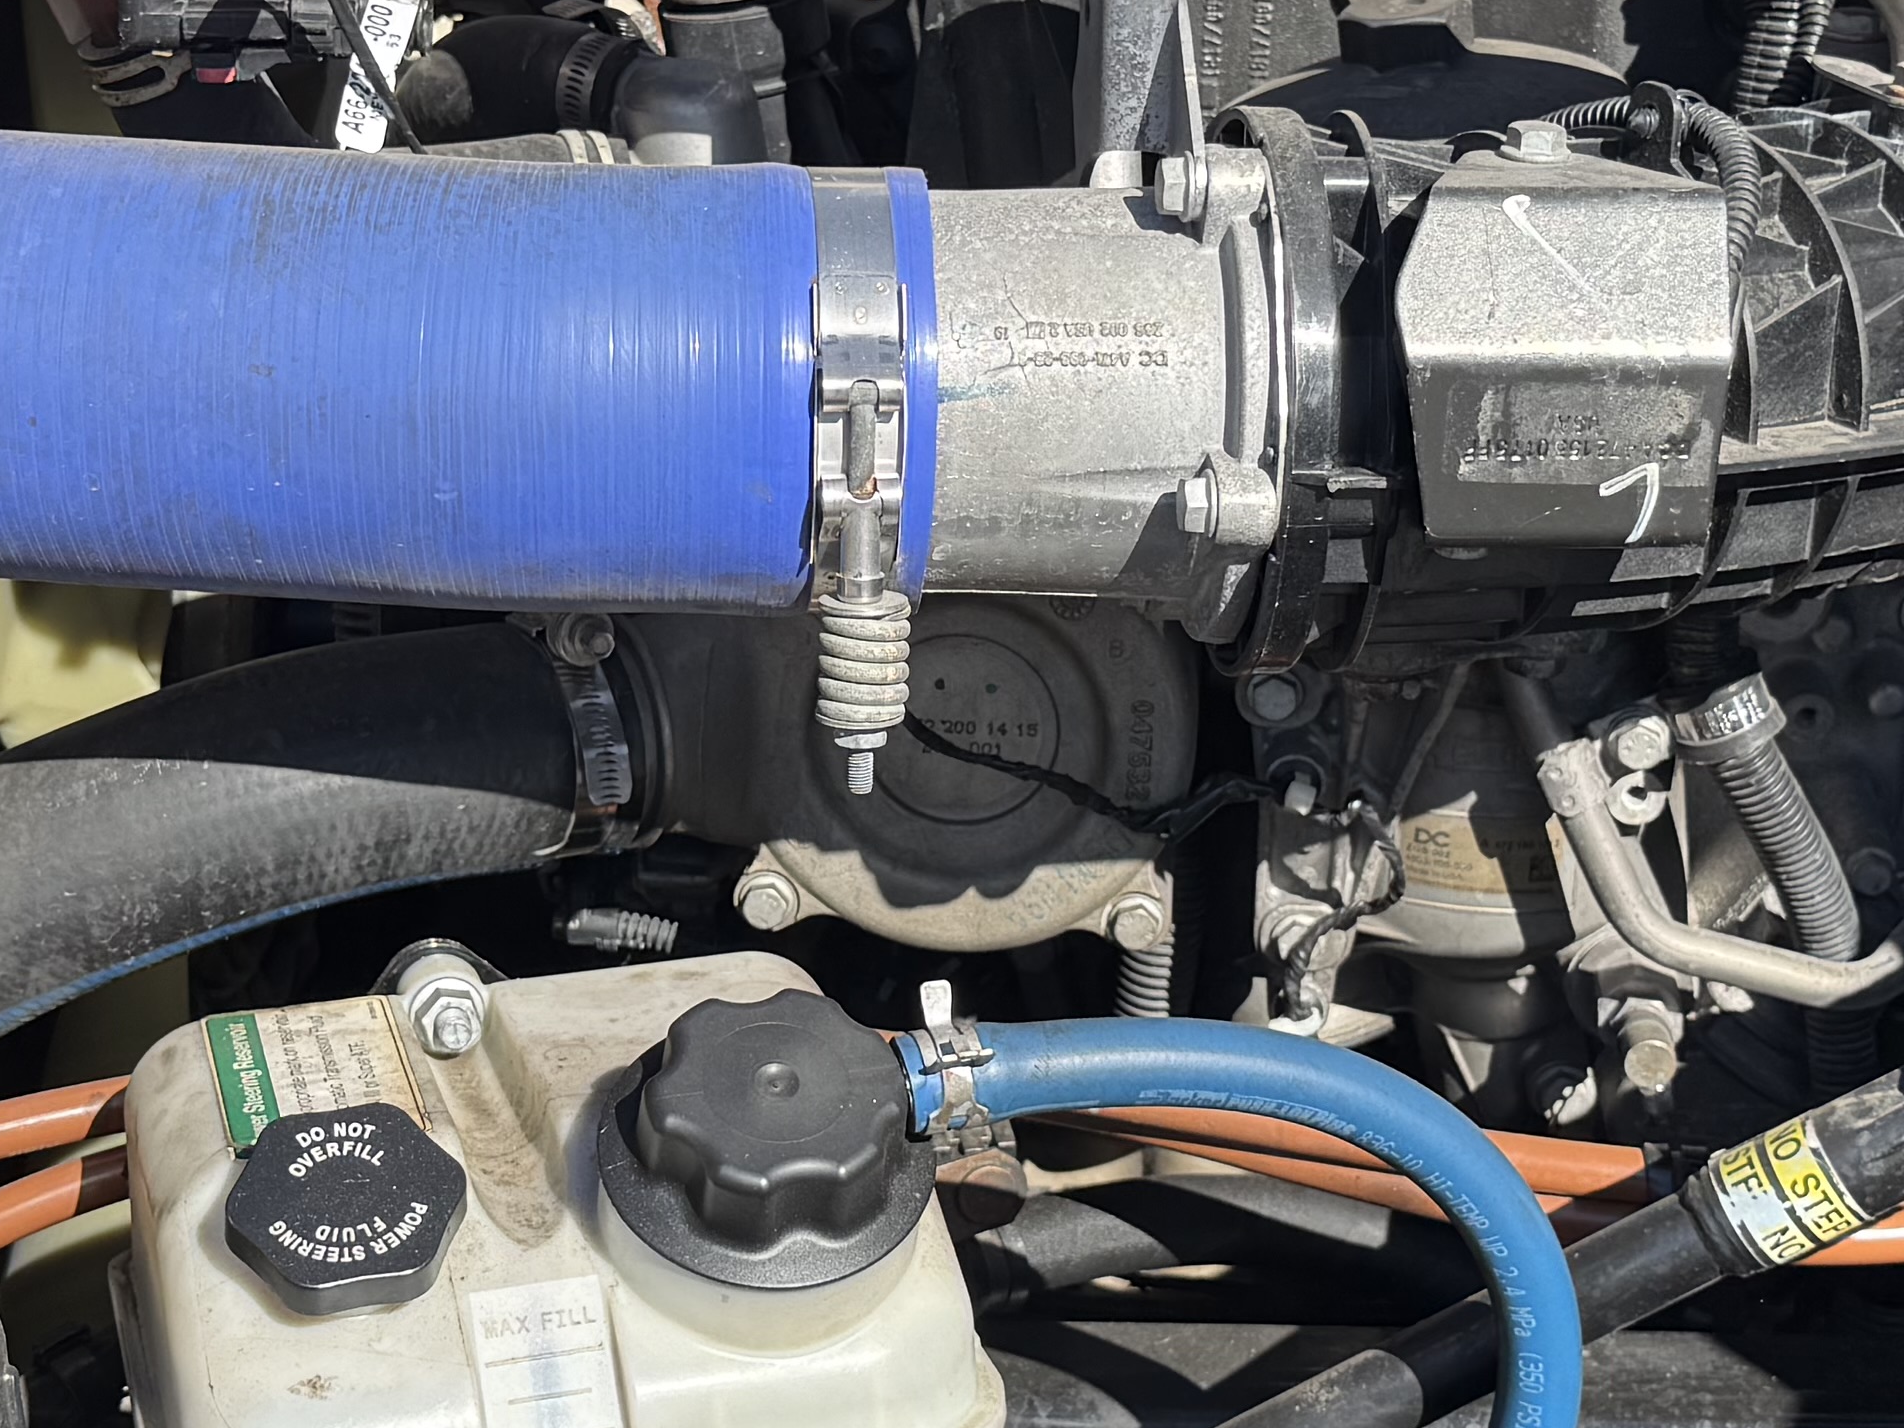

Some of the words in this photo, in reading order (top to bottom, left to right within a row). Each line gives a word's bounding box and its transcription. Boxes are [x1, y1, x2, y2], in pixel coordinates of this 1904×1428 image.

[1138, 351, 1168, 367] DC
[941, 720, 977, 736] 200
[986, 720, 1007, 737] 14
[1016, 721, 1038, 737] 15
[1414, 826, 1450, 847] DC
[306, 1015, 324, 1032] Fluid
[225, 1023, 255, 1069] Reservoir
[314, 1033, 342, 1082] Transmission
[355, 1058, 375, 1079] Super
[239, 1069, 265, 1113] Steering
[295, 1126, 325, 1148] DO
[333, 1122, 376, 1140] NOT
[1356, 1131, 1424, 1171] 836-10
[288, 1141, 385, 1178] OVERFILL
[1724, 1147, 1768, 1200] STE
[1769, 1121, 1802, 1161] NO
[1790, 1173, 1853, 1241] STEP
[1423, 1171, 1490, 1230] HI-TEMP
[268, 1220, 366, 1262] STEERING
[315, 1216, 387, 1242] FLUID
[372, 1201, 429, 1255] POWER
[1478, 1235, 1509, 1260] WP
[1493, 1264, 1527, 1306] 2.4
[481, 1315, 532, 1340] MAX
[539, 1307, 599, 1333] FILL
[1514, 1305, 1534, 1337] MPa
[1518, 1350, 1545, 1395] (350
